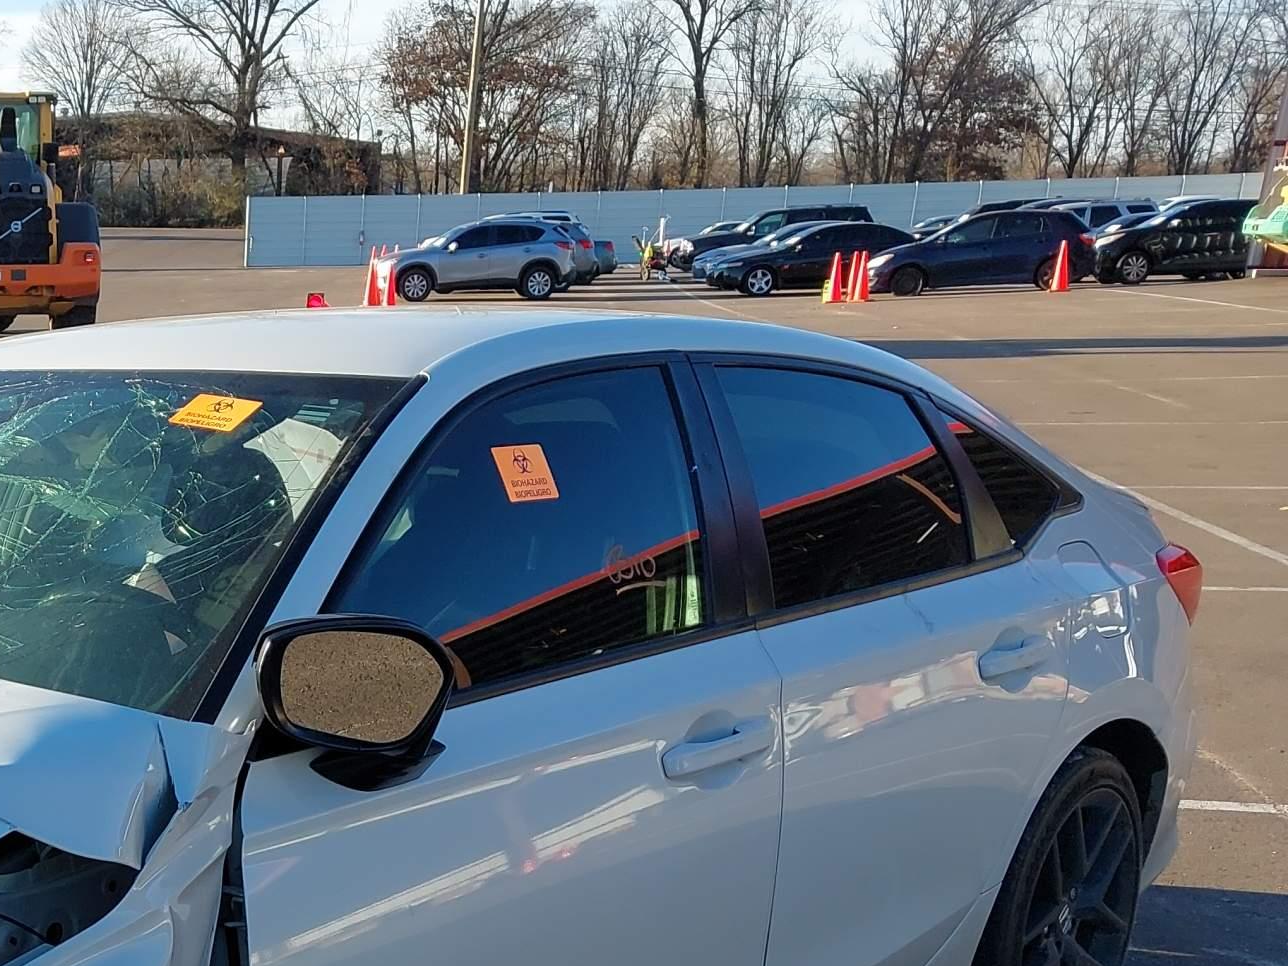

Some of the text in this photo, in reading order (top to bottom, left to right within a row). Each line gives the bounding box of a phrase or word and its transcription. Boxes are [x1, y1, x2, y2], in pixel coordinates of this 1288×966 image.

[185, 412, 233, 422] BIOHAZARD
[178, 418, 227, 428] BIOPELIGRO
[511, 477, 548, 488] BIOHAZARD
[514, 488, 552, 499] BIOPELIGRO
